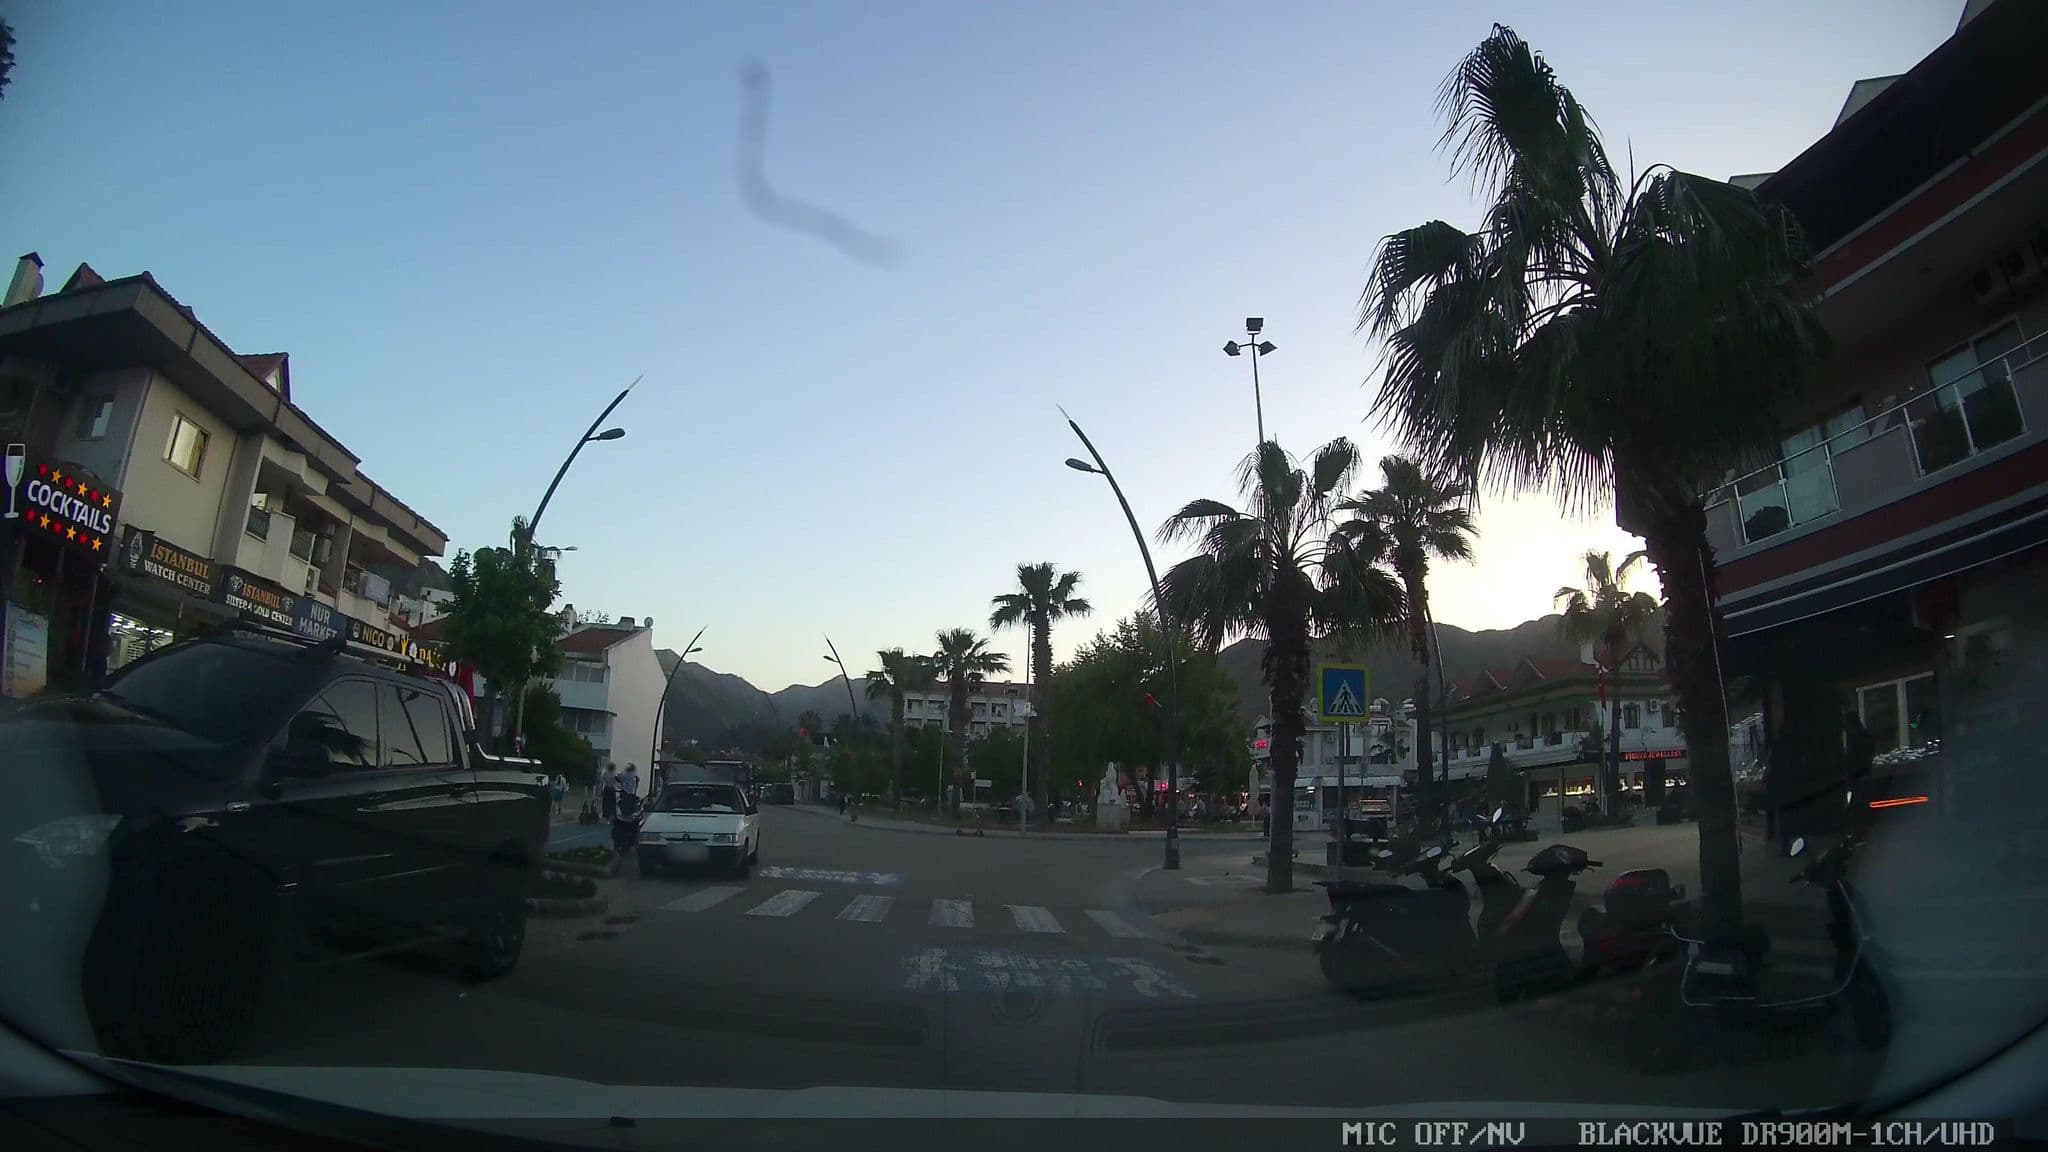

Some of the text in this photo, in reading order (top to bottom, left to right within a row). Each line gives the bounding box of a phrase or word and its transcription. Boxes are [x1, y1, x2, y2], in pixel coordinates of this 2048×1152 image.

[27, 480, 112, 535] COCKTAILS
[144, 559, 211, 595] WATCH CENTER
[271, 611, 294, 626] CENTER
[310, 604, 331, 625] NUR
[300, 617, 338, 641] MARKET
[362, 626, 385, 648] NICO
